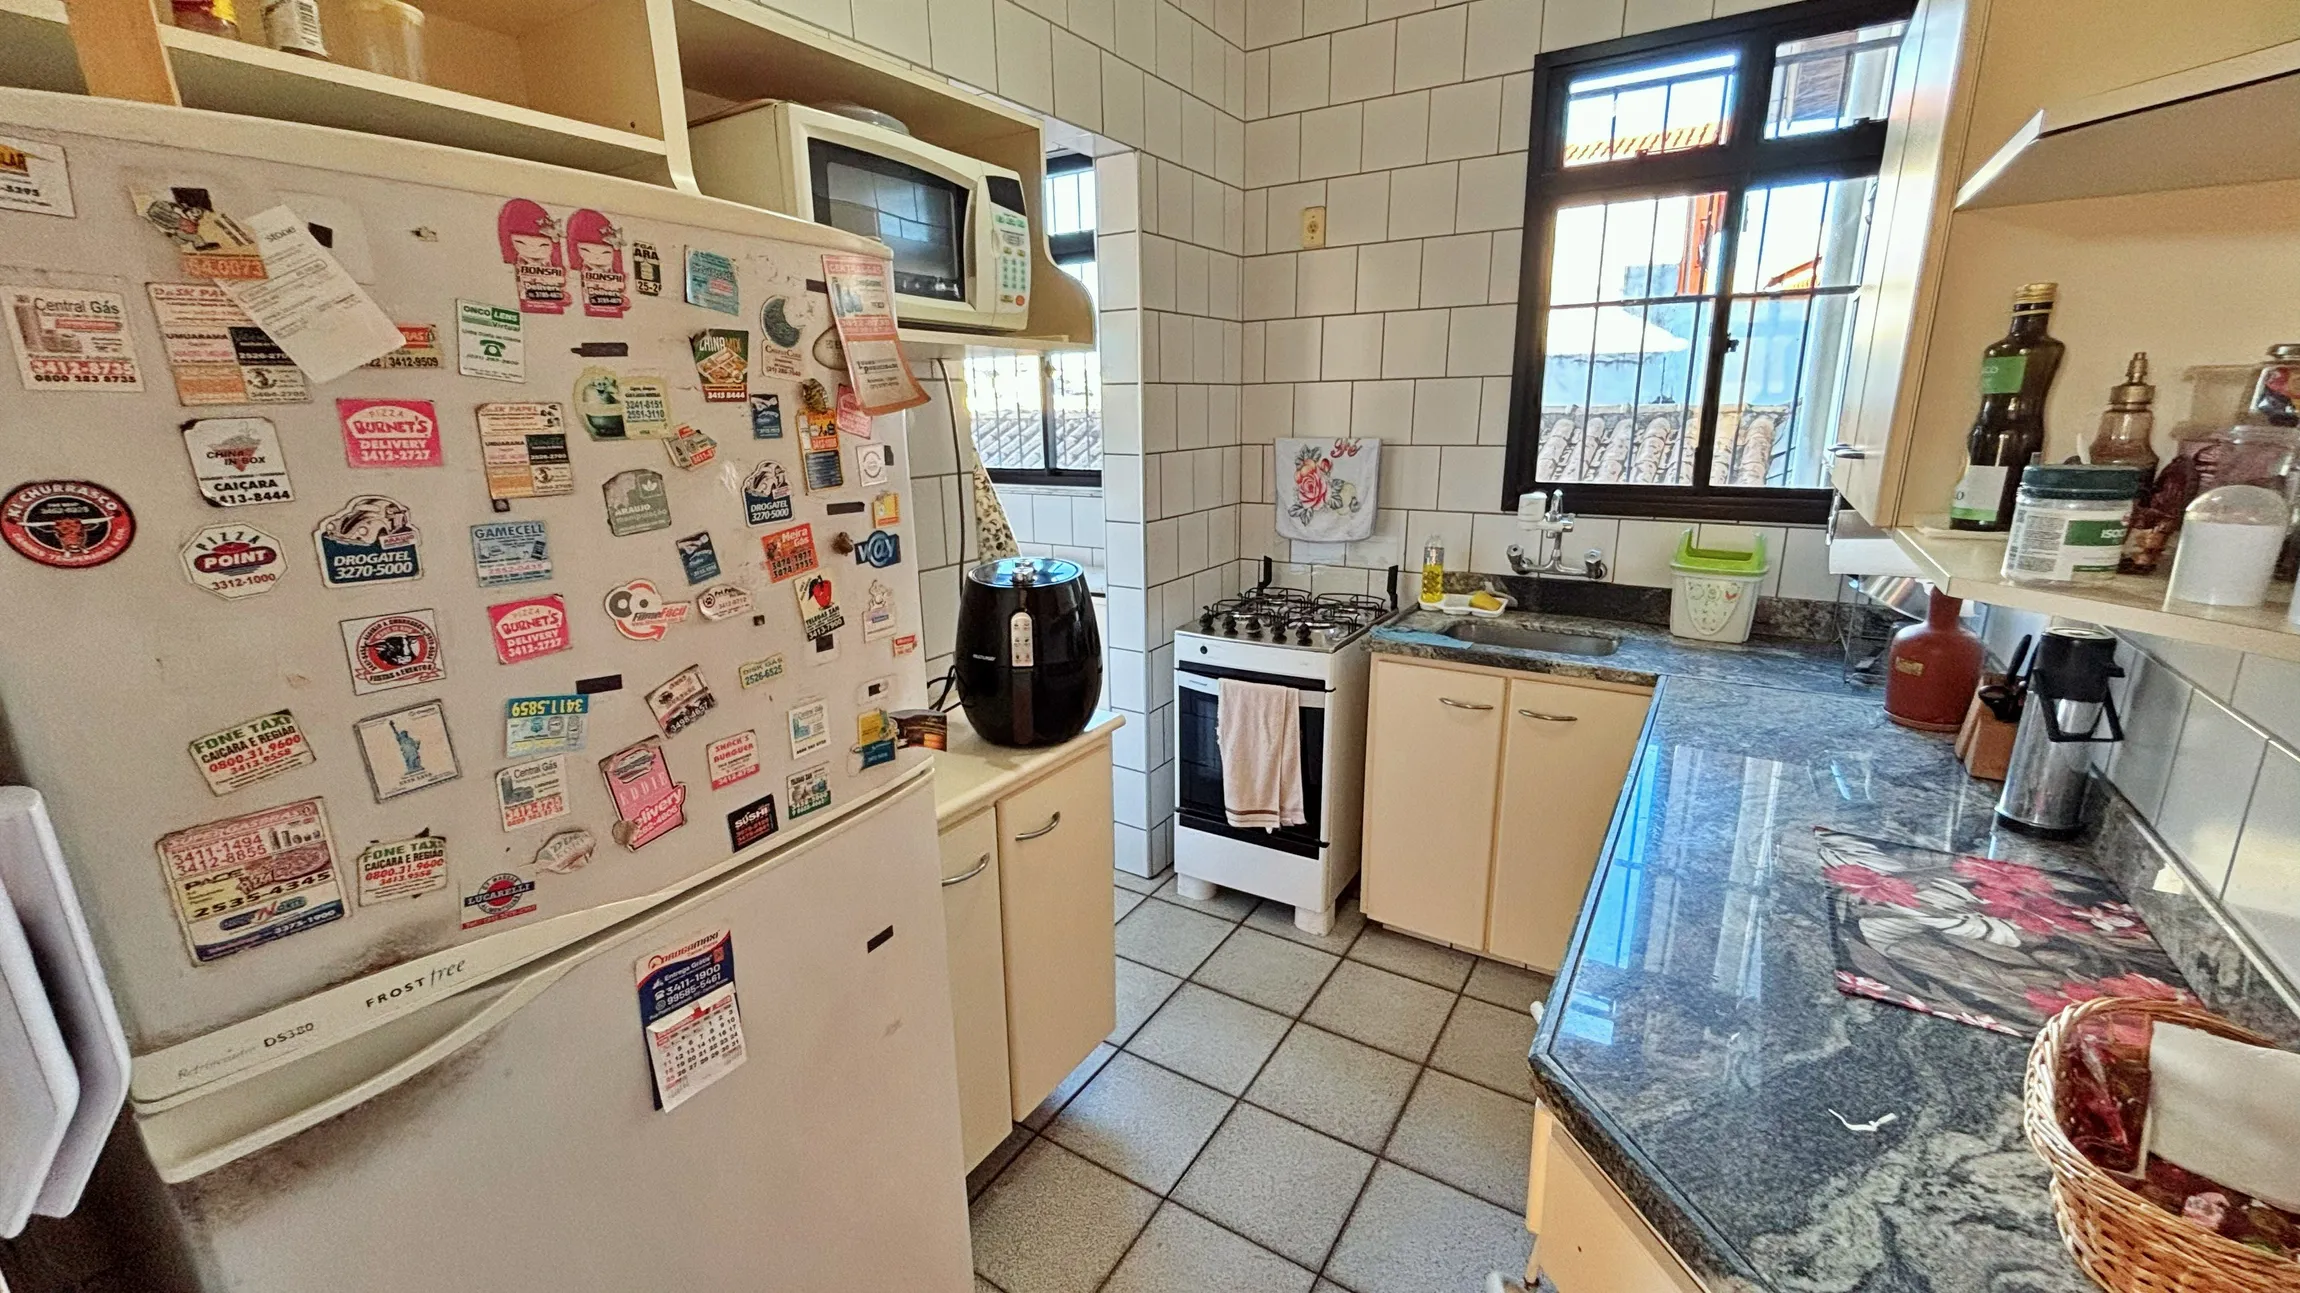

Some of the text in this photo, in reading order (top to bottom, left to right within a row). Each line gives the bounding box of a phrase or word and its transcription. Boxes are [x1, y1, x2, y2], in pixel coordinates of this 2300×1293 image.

[520, 266, 563, 277] BONSAI
[585, 271, 624, 282] BONSAI
[33, 298, 120, 315] Central Gás
[353, 415, 429, 435] BURNET'S
[359, 439, 427, 450] DELIVERY
[206, 450, 246, 460] CHINA
[224, 456, 266, 466] IN BOX
[213, 479, 278, 493] CAIÇARA
[8, 503, 24, 518] KI
[19, 483, 118, 511] CHURRASCO
[213, 490, 291, 504] 413-8444
[750, 500, 788, 512] DROGATEL
[474, 524, 545, 539] GAMECELL
[781, 528, 808, 543] Meira
[204, 550, 268, 570] POINT
[333, 551, 412, 566] DROGATEL
[334, 562, 413, 579] 3270-5000
[211, 572, 277, 592] 3312-1000
[501, 610, 560, 635] BURNET'S
[506, 629, 560, 648] DELIVERY
[194, 714, 292, 755] FONE TAXI
[248, 737, 258, 748] E
[513, 764, 541, 779] Central
[173, 834, 263, 867] 3411-1494
[363, 845, 405, 863] FONE
[467, 882, 531, 905] LUCARELLI
[664, 966, 691, 982] Entrega
[665, 963, 721, 997] 3411-1900
[365, 958, 467, 1009] FROST free
